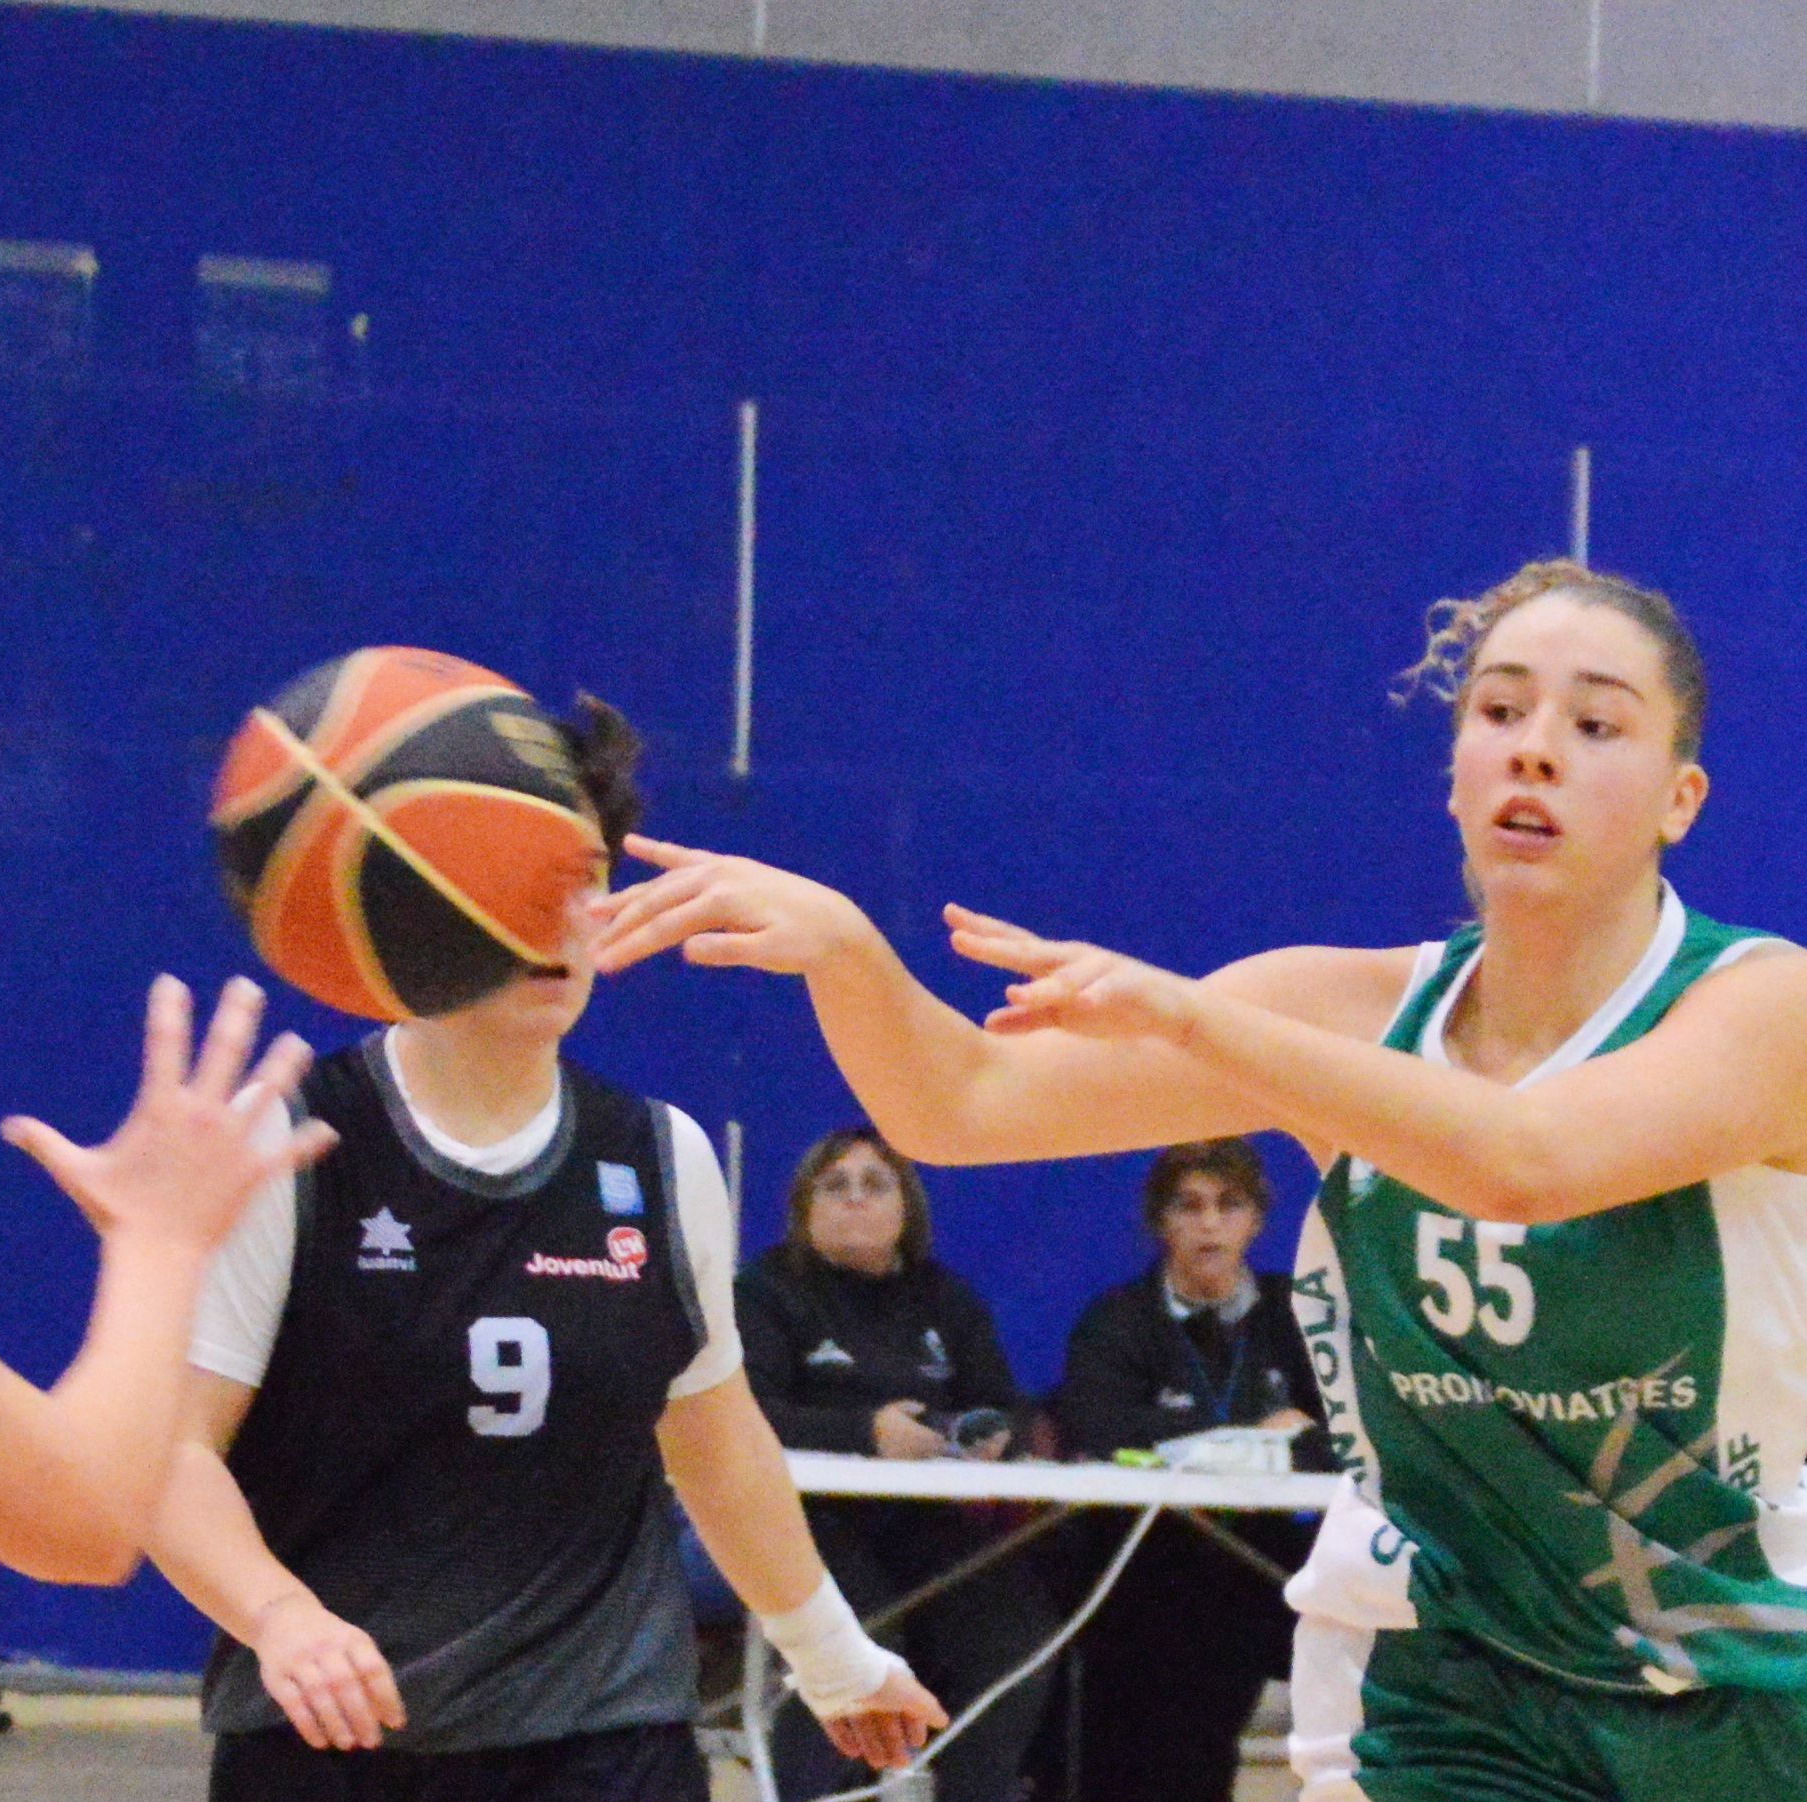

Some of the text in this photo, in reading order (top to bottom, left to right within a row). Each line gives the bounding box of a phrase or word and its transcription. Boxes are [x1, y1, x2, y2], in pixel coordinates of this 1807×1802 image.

[524, 1251, 641, 1280] Joventut
[1414, 1211, 1535, 1346] 55
[467, 1316, 552, 1437] 9
